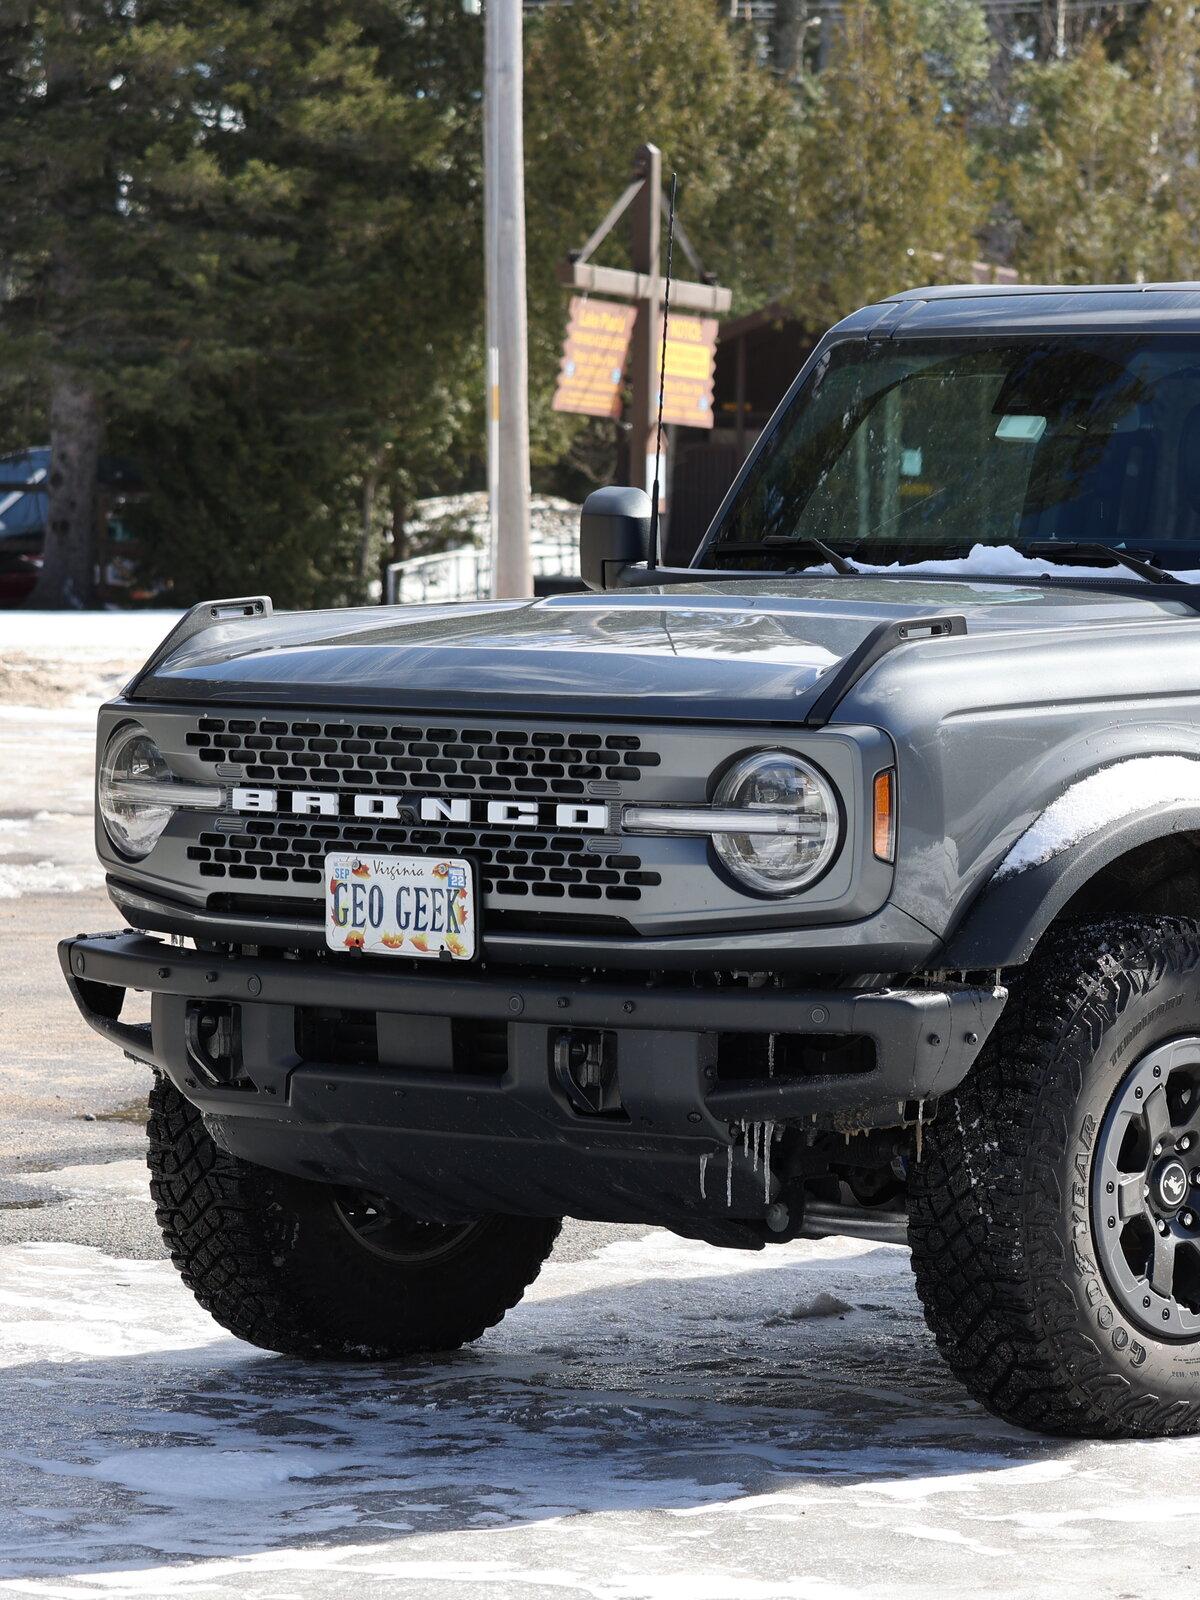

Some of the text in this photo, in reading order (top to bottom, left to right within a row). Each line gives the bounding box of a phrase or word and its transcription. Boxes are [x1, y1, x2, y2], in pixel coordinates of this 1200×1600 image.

[231, 787, 609, 830] BRONCO
[334, 867, 350, 880] SEP
[372, 859, 424, 880] Virginia
[451, 875, 465, 887] 22
[333, 882, 461, 934] GEO GEEK
